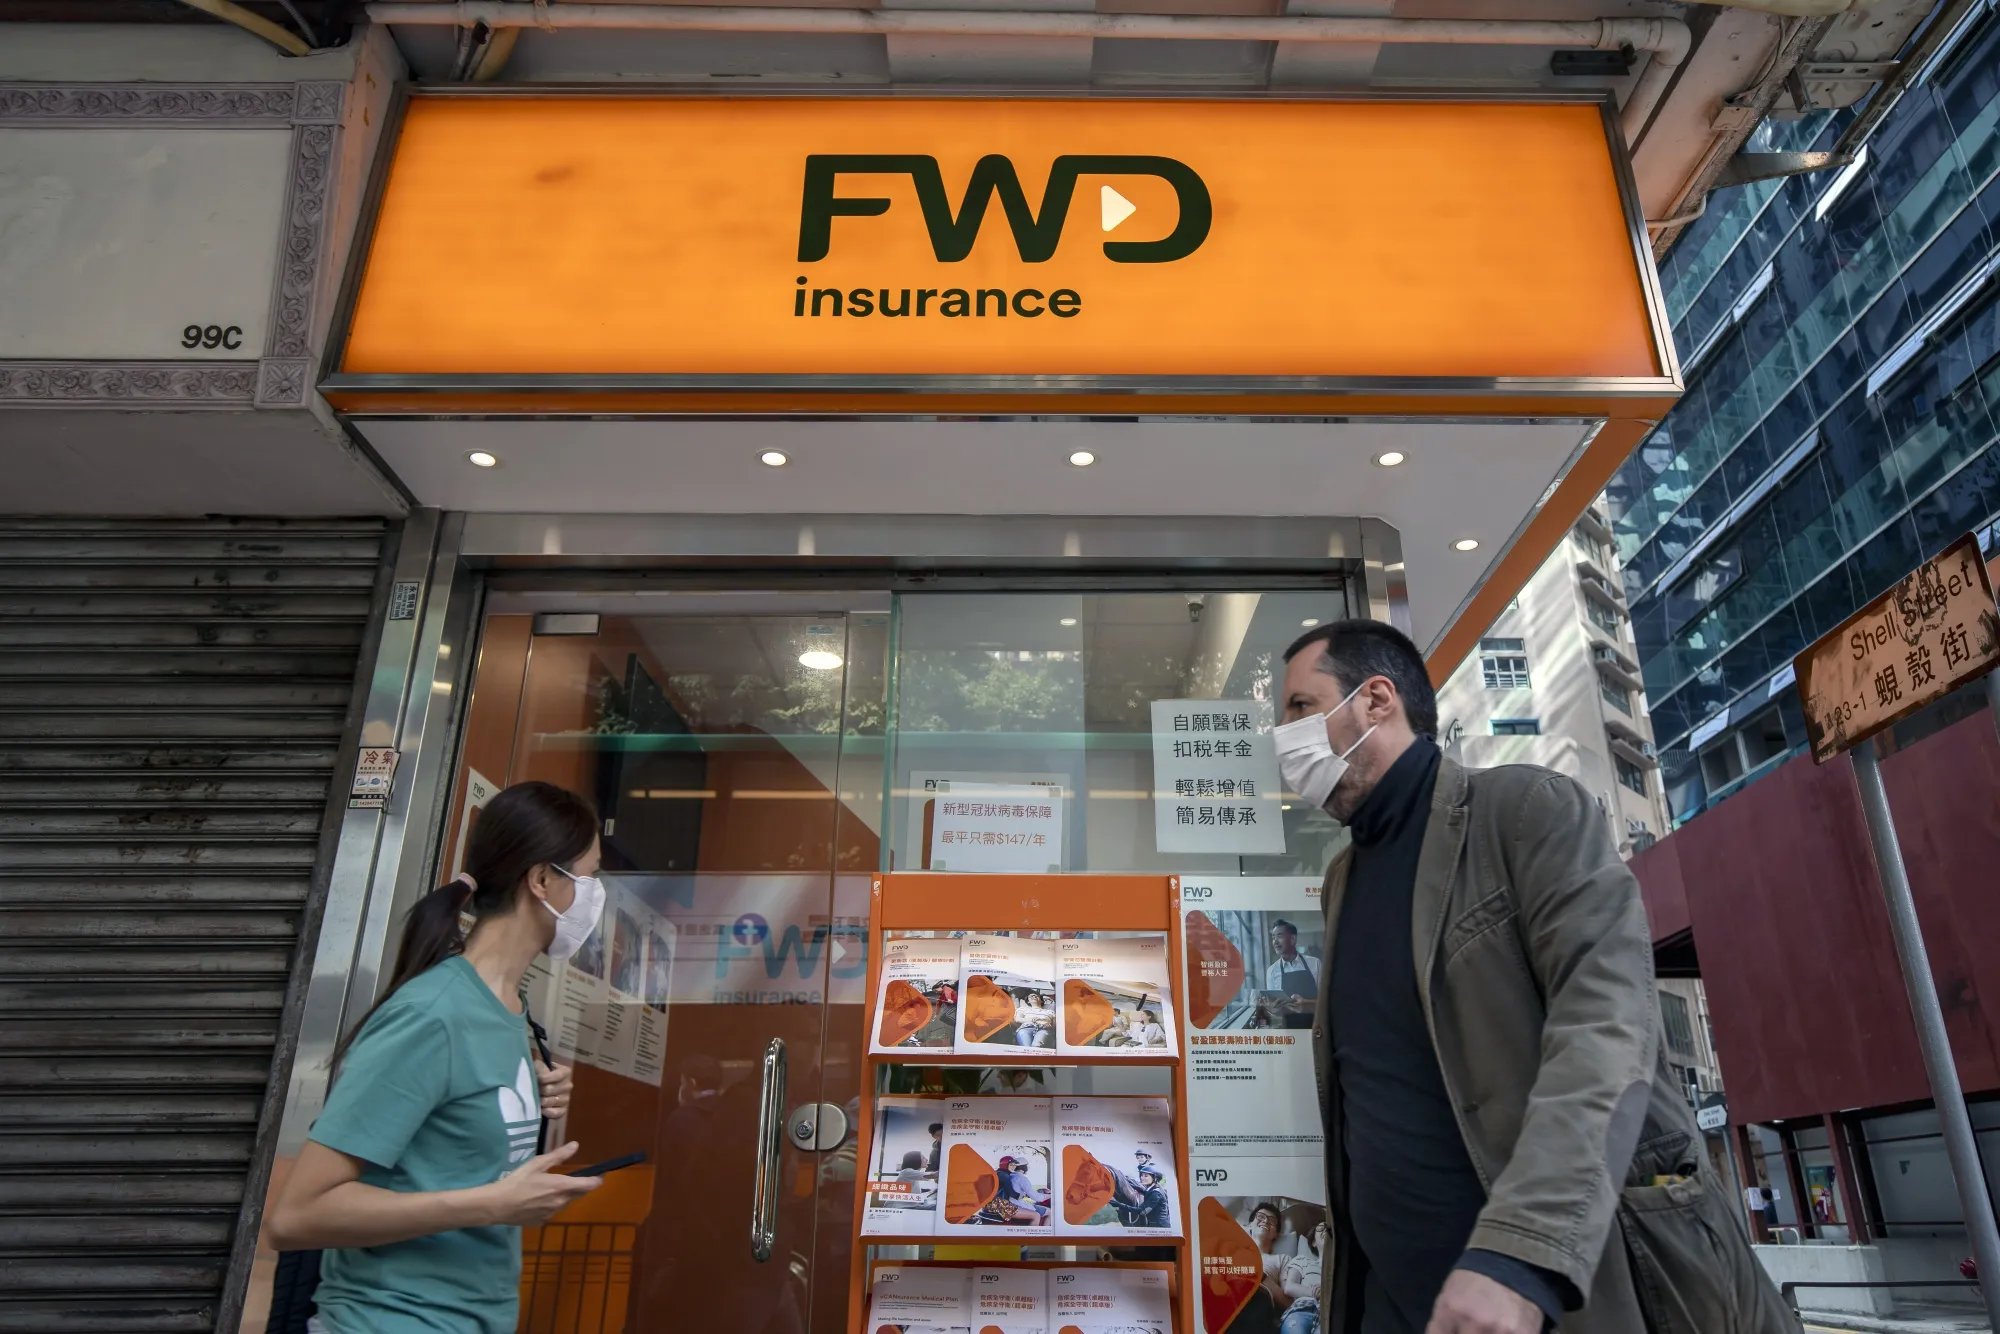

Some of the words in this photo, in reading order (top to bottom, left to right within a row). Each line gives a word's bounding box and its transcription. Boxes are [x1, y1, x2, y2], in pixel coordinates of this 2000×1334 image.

[797, 154, 1212, 263] FWD
[794, 276, 1082, 318] insurance
[181, 325, 243, 350] 99C
[1851, 611, 1897, 661] Shell
[1901, 560, 1973, 627] Street
[1875, 622, 1970, 708] 蜆殼街
[1174, 713, 1251, 732] 自願醫保
[1175, 779, 1256, 798] 輕鬆增值
[943, 802, 1052, 819] 新型冠狀病毒保障
[1176, 805, 1257, 825] 簡易傳承
[941, 830, 1046, 846] 最平只需$147/年
[1184, 887, 1212, 898] FWD
[715, 924, 868, 980] FWD
[712, 986, 822, 1005] insurance
[1196, 1169, 1228, 1181] FWD
